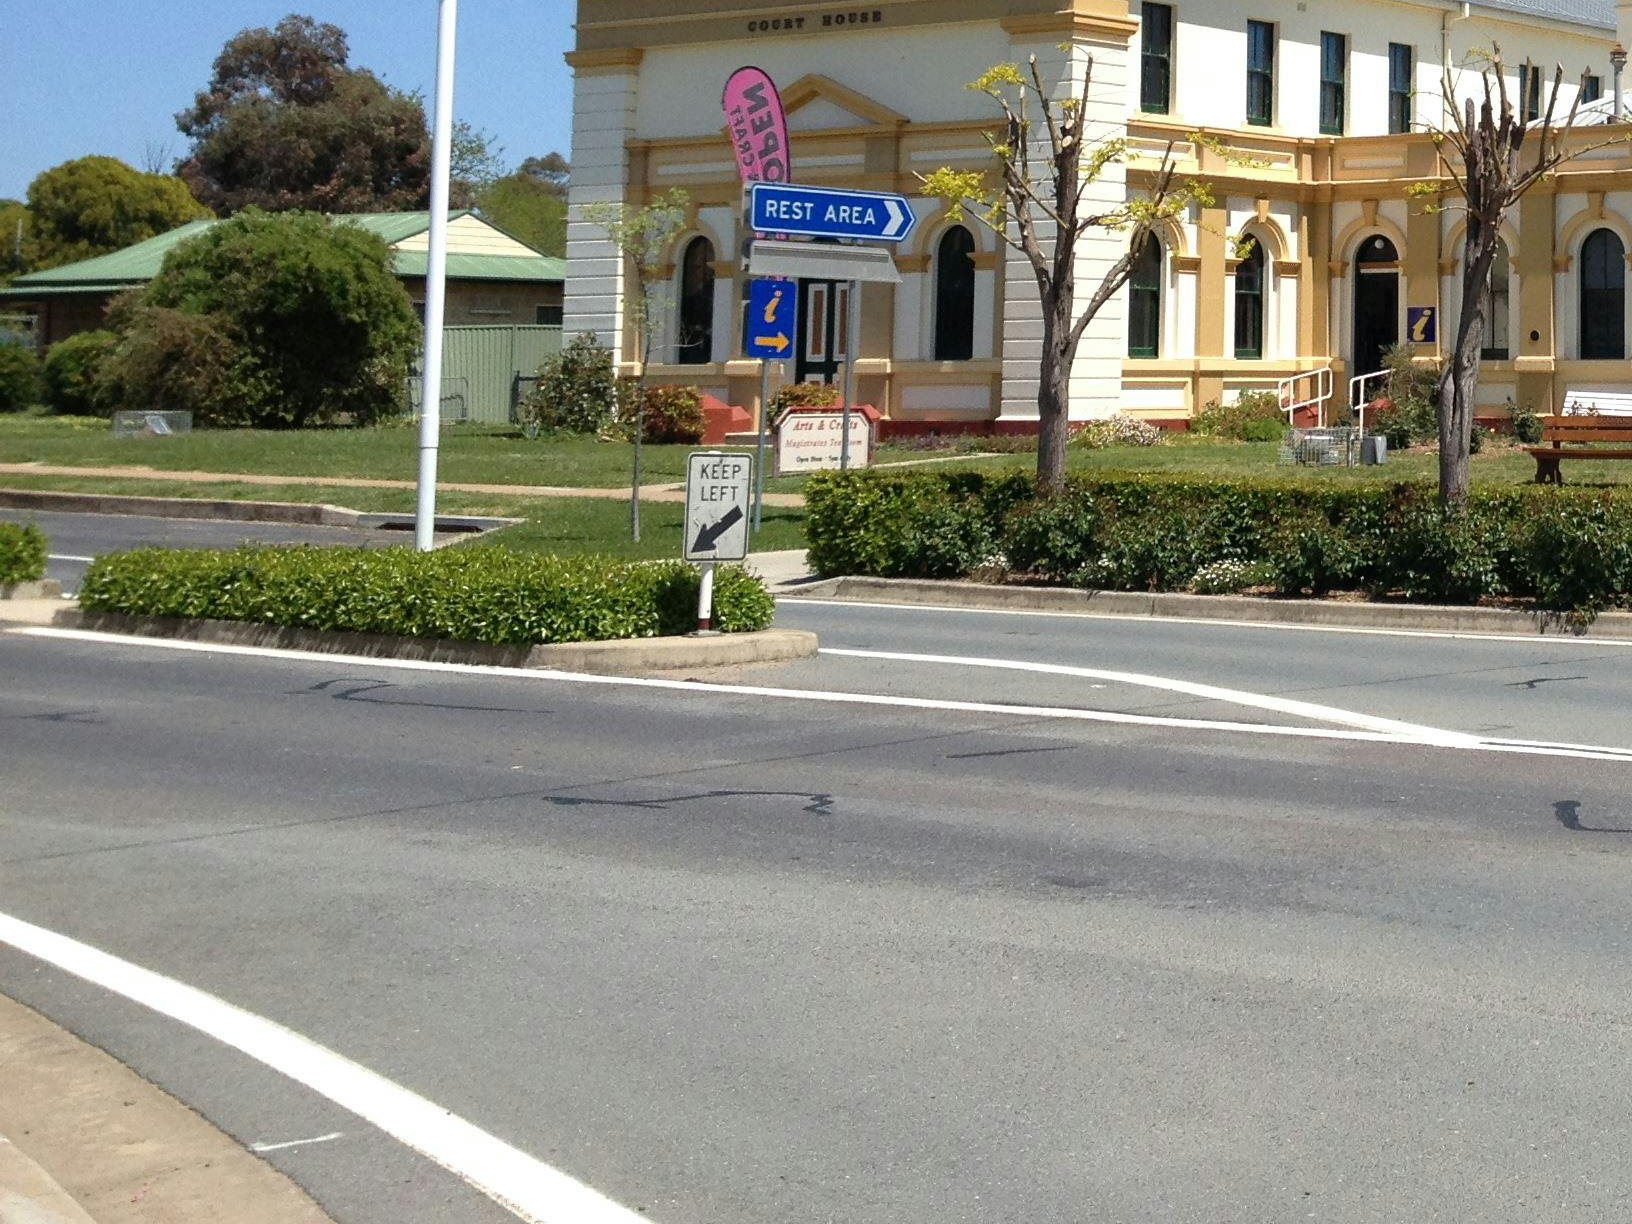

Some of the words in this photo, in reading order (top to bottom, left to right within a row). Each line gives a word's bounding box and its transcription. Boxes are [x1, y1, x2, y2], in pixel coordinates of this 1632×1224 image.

[747, 17, 804, 32] COURT
[822, 11, 882, 26] HOUSE
[765, 199, 814, 221] REST
[824, 204, 876, 225] AREA
[793, 420, 814, 431] Arts
[700, 463, 742, 480] KEEP
[700, 485, 739, 502] LEFT
